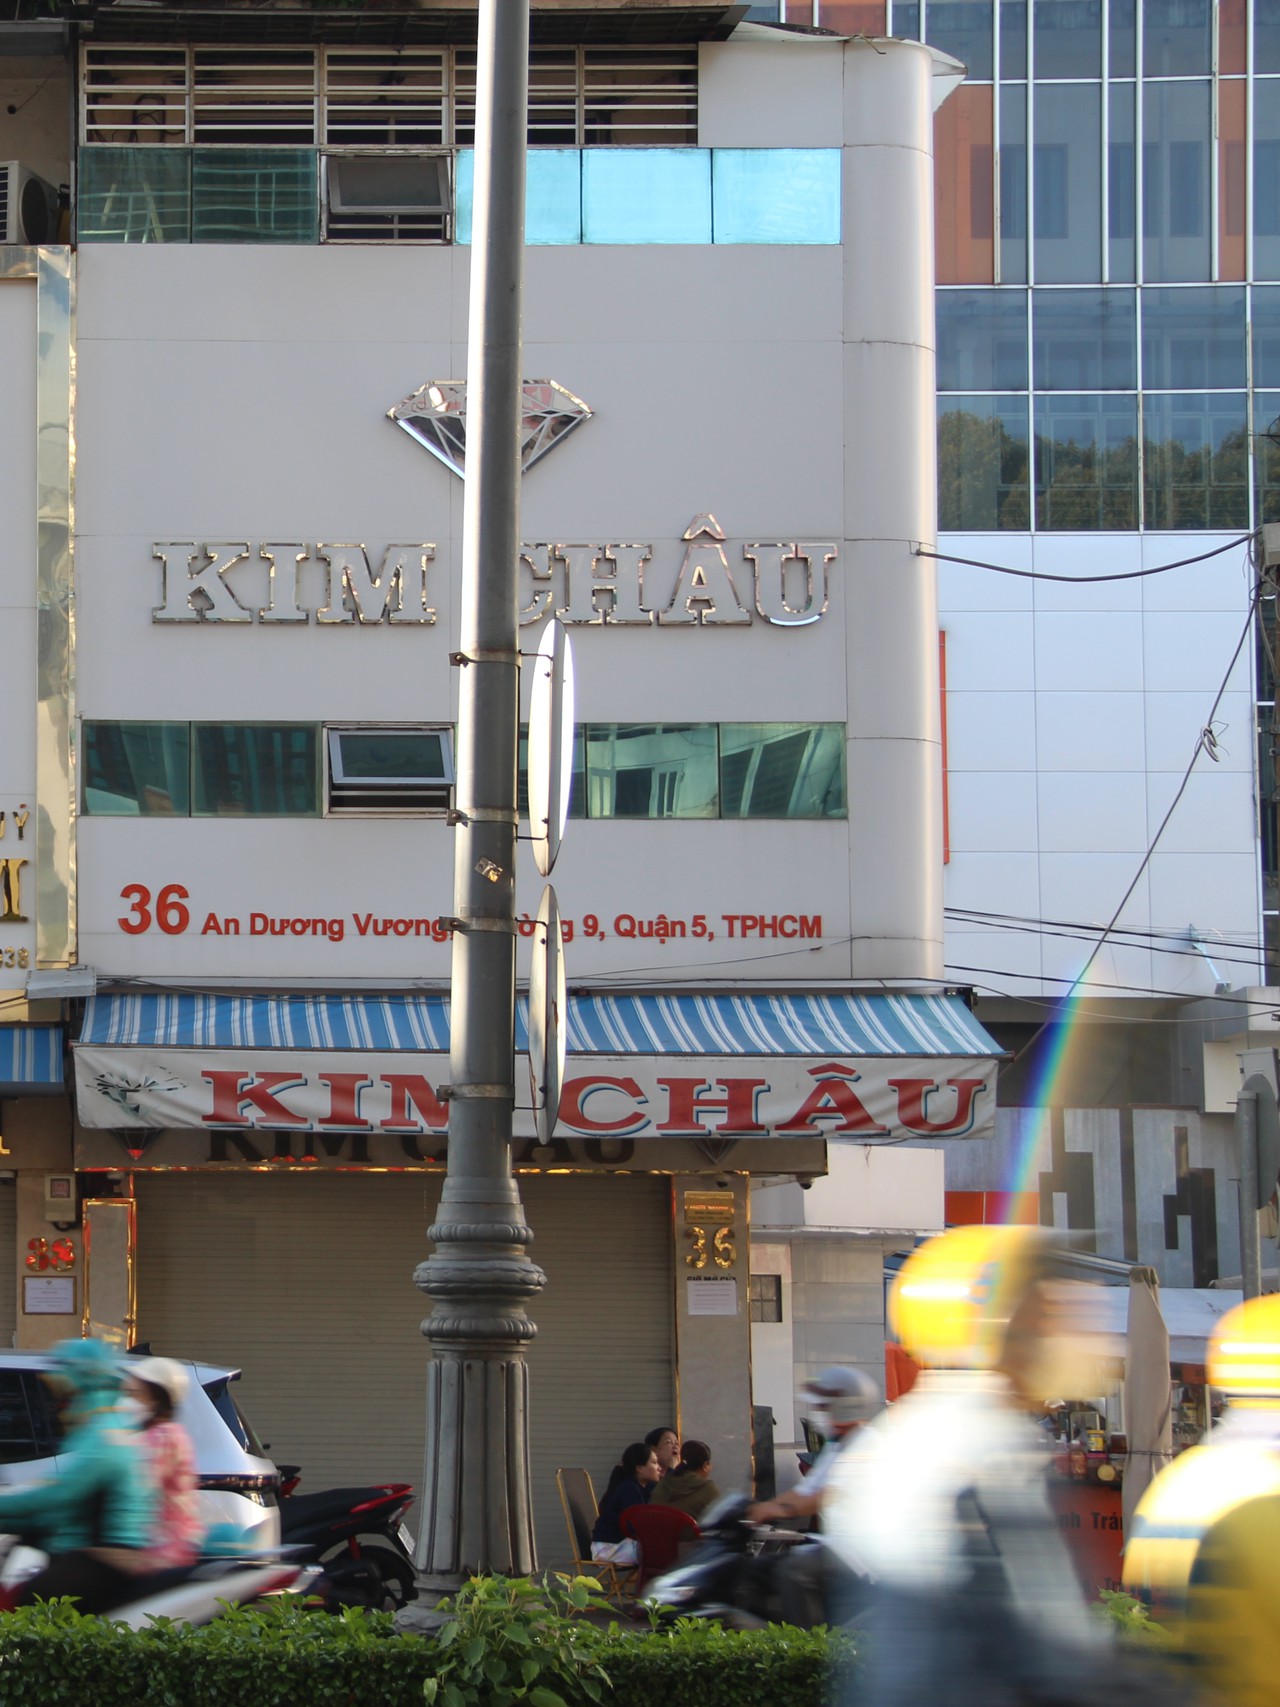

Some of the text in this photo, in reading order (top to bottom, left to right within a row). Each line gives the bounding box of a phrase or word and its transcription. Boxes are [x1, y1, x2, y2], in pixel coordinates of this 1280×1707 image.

[151, 541, 437, 626] KIM
[117, 883, 190, 935] 36
[201, 912, 240, 936] An
[249, 912, 345, 942] Dương
[582, 914, 605, 941] 9,
[613, 913, 686, 944] Quận
[691, 915, 715, 942] 5,
[721, 914, 823, 939] TPHCM
[558, 1061, 988, 1137] CHÂU
[683, 1226, 737, 1269] 36
[1091, 1511, 1123, 1530] Trá
